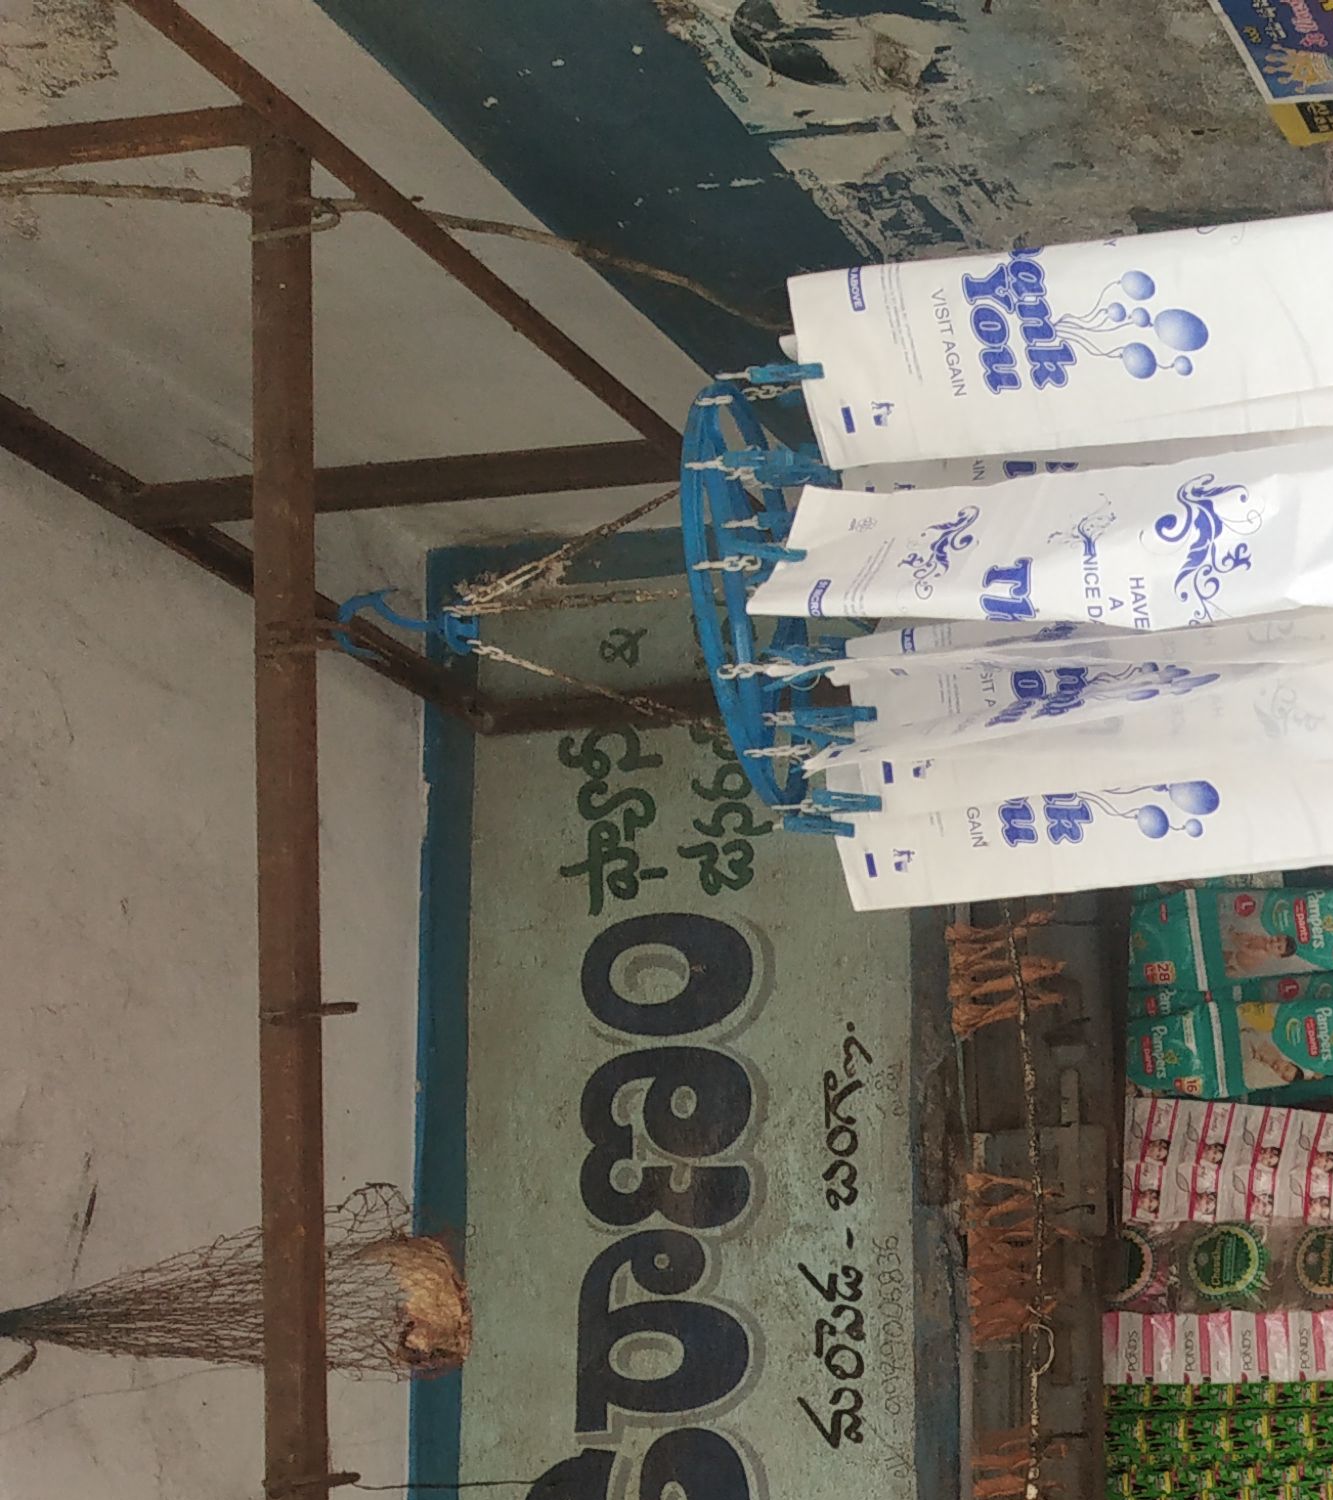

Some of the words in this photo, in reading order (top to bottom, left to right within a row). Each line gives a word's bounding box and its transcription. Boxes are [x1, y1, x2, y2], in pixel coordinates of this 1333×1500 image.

[930, 287, 955, 336] VISIT
[961, 263, 1022, 395] You
[942, 340, 968, 397] AGAIN
[1083, 553, 1100, 598] NICE
[1109, 596, 1125, 610] A
[1129, 576, 1151, 629] HAVE
